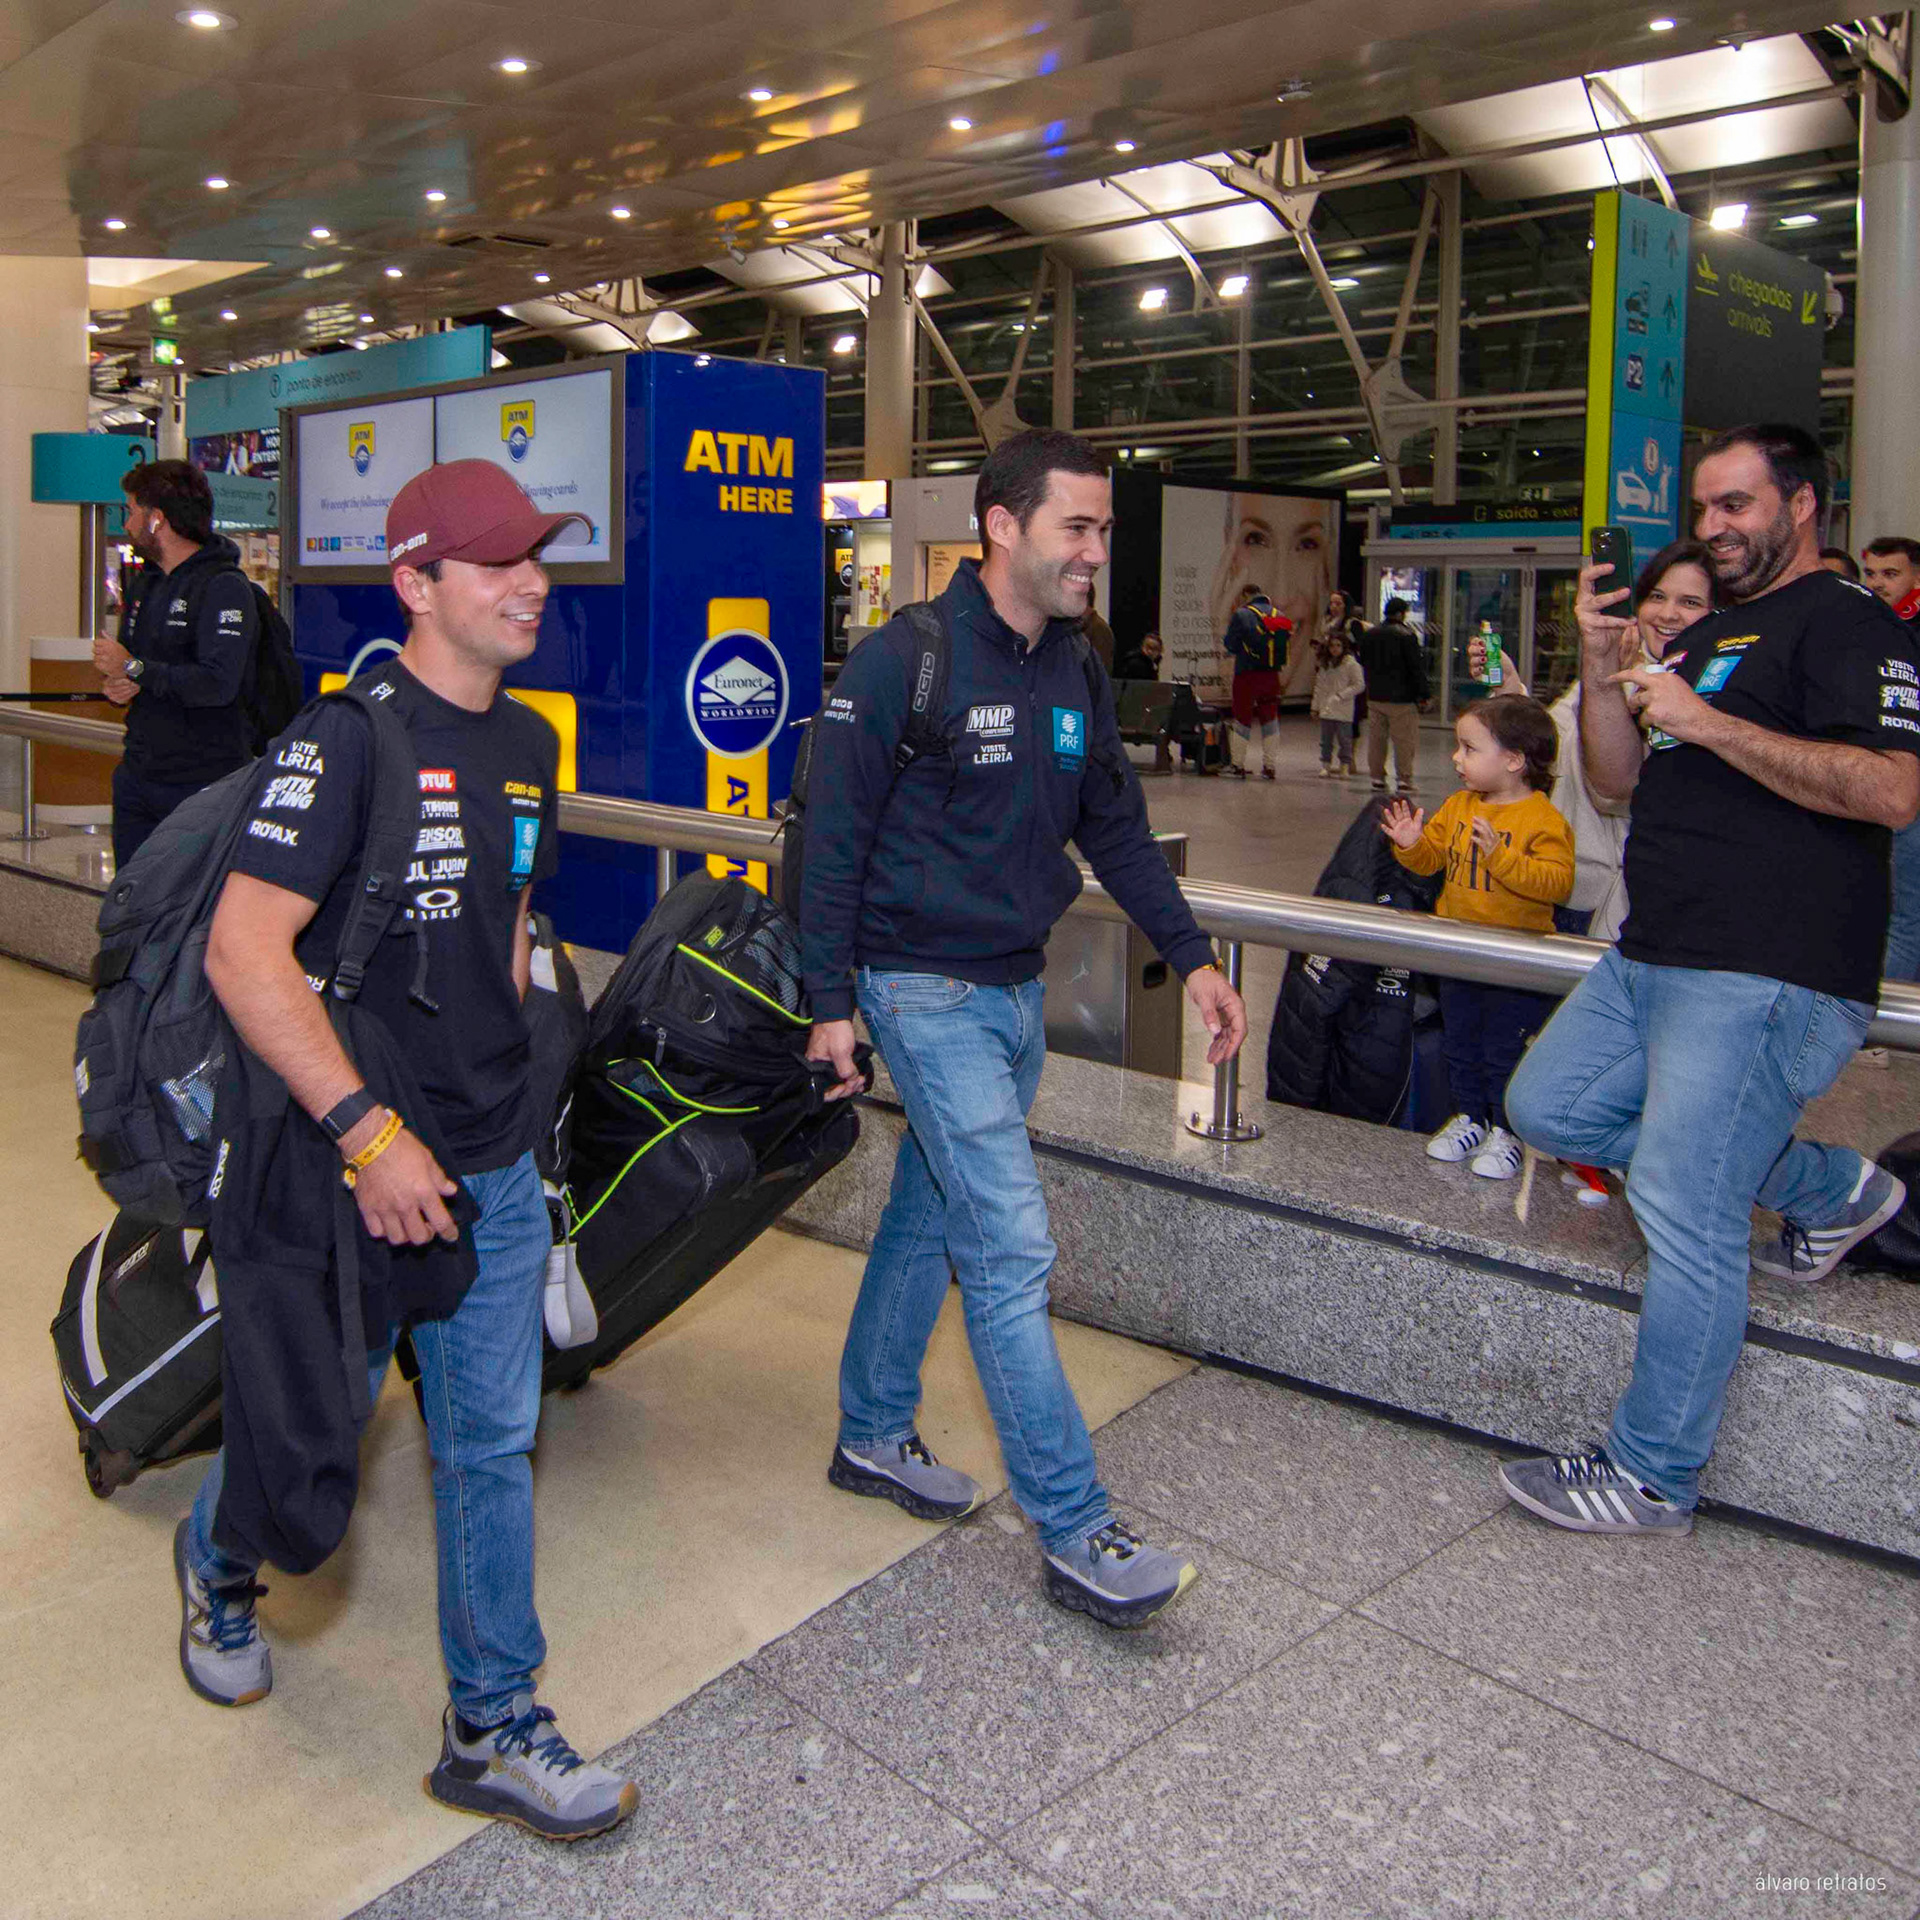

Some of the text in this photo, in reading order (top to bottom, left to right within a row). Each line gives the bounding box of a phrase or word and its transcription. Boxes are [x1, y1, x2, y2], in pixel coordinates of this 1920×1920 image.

[1729, 272, 1793, 312] chegadas
[1727, 308, 1773, 338] arrivals
[507, 410, 529, 422] ATM
[354, 430, 371, 441] ATM
[684, 429, 794, 478] ATM
[267, 490, 277, 517] 2
[719, 485, 793, 514] HERE
[1552, 505, 1579, 518] exit
[840, 553, 853, 562] AT
[1886, 659, 1916, 674] VISITE
[714, 674, 765, 690] Euronet
[912, 651, 936, 713] OGIO
[1880, 666, 1920, 687] LEIRIA
[1881, 685, 1920, 699] SOUTH
[700, 707, 777, 719] WORLDWIDE
[968, 707, 1013, 730] MMP
[980, 744, 1007, 753] VISITE
[1060, 733, 1079, 749] PRF
[973, 752, 1014, 765] LEIRIA
[420, 773, 453, 788] OTUL
[418, 828, 464, 844] ENSOR
[1376, 986, 1408, 997] AKLEY
